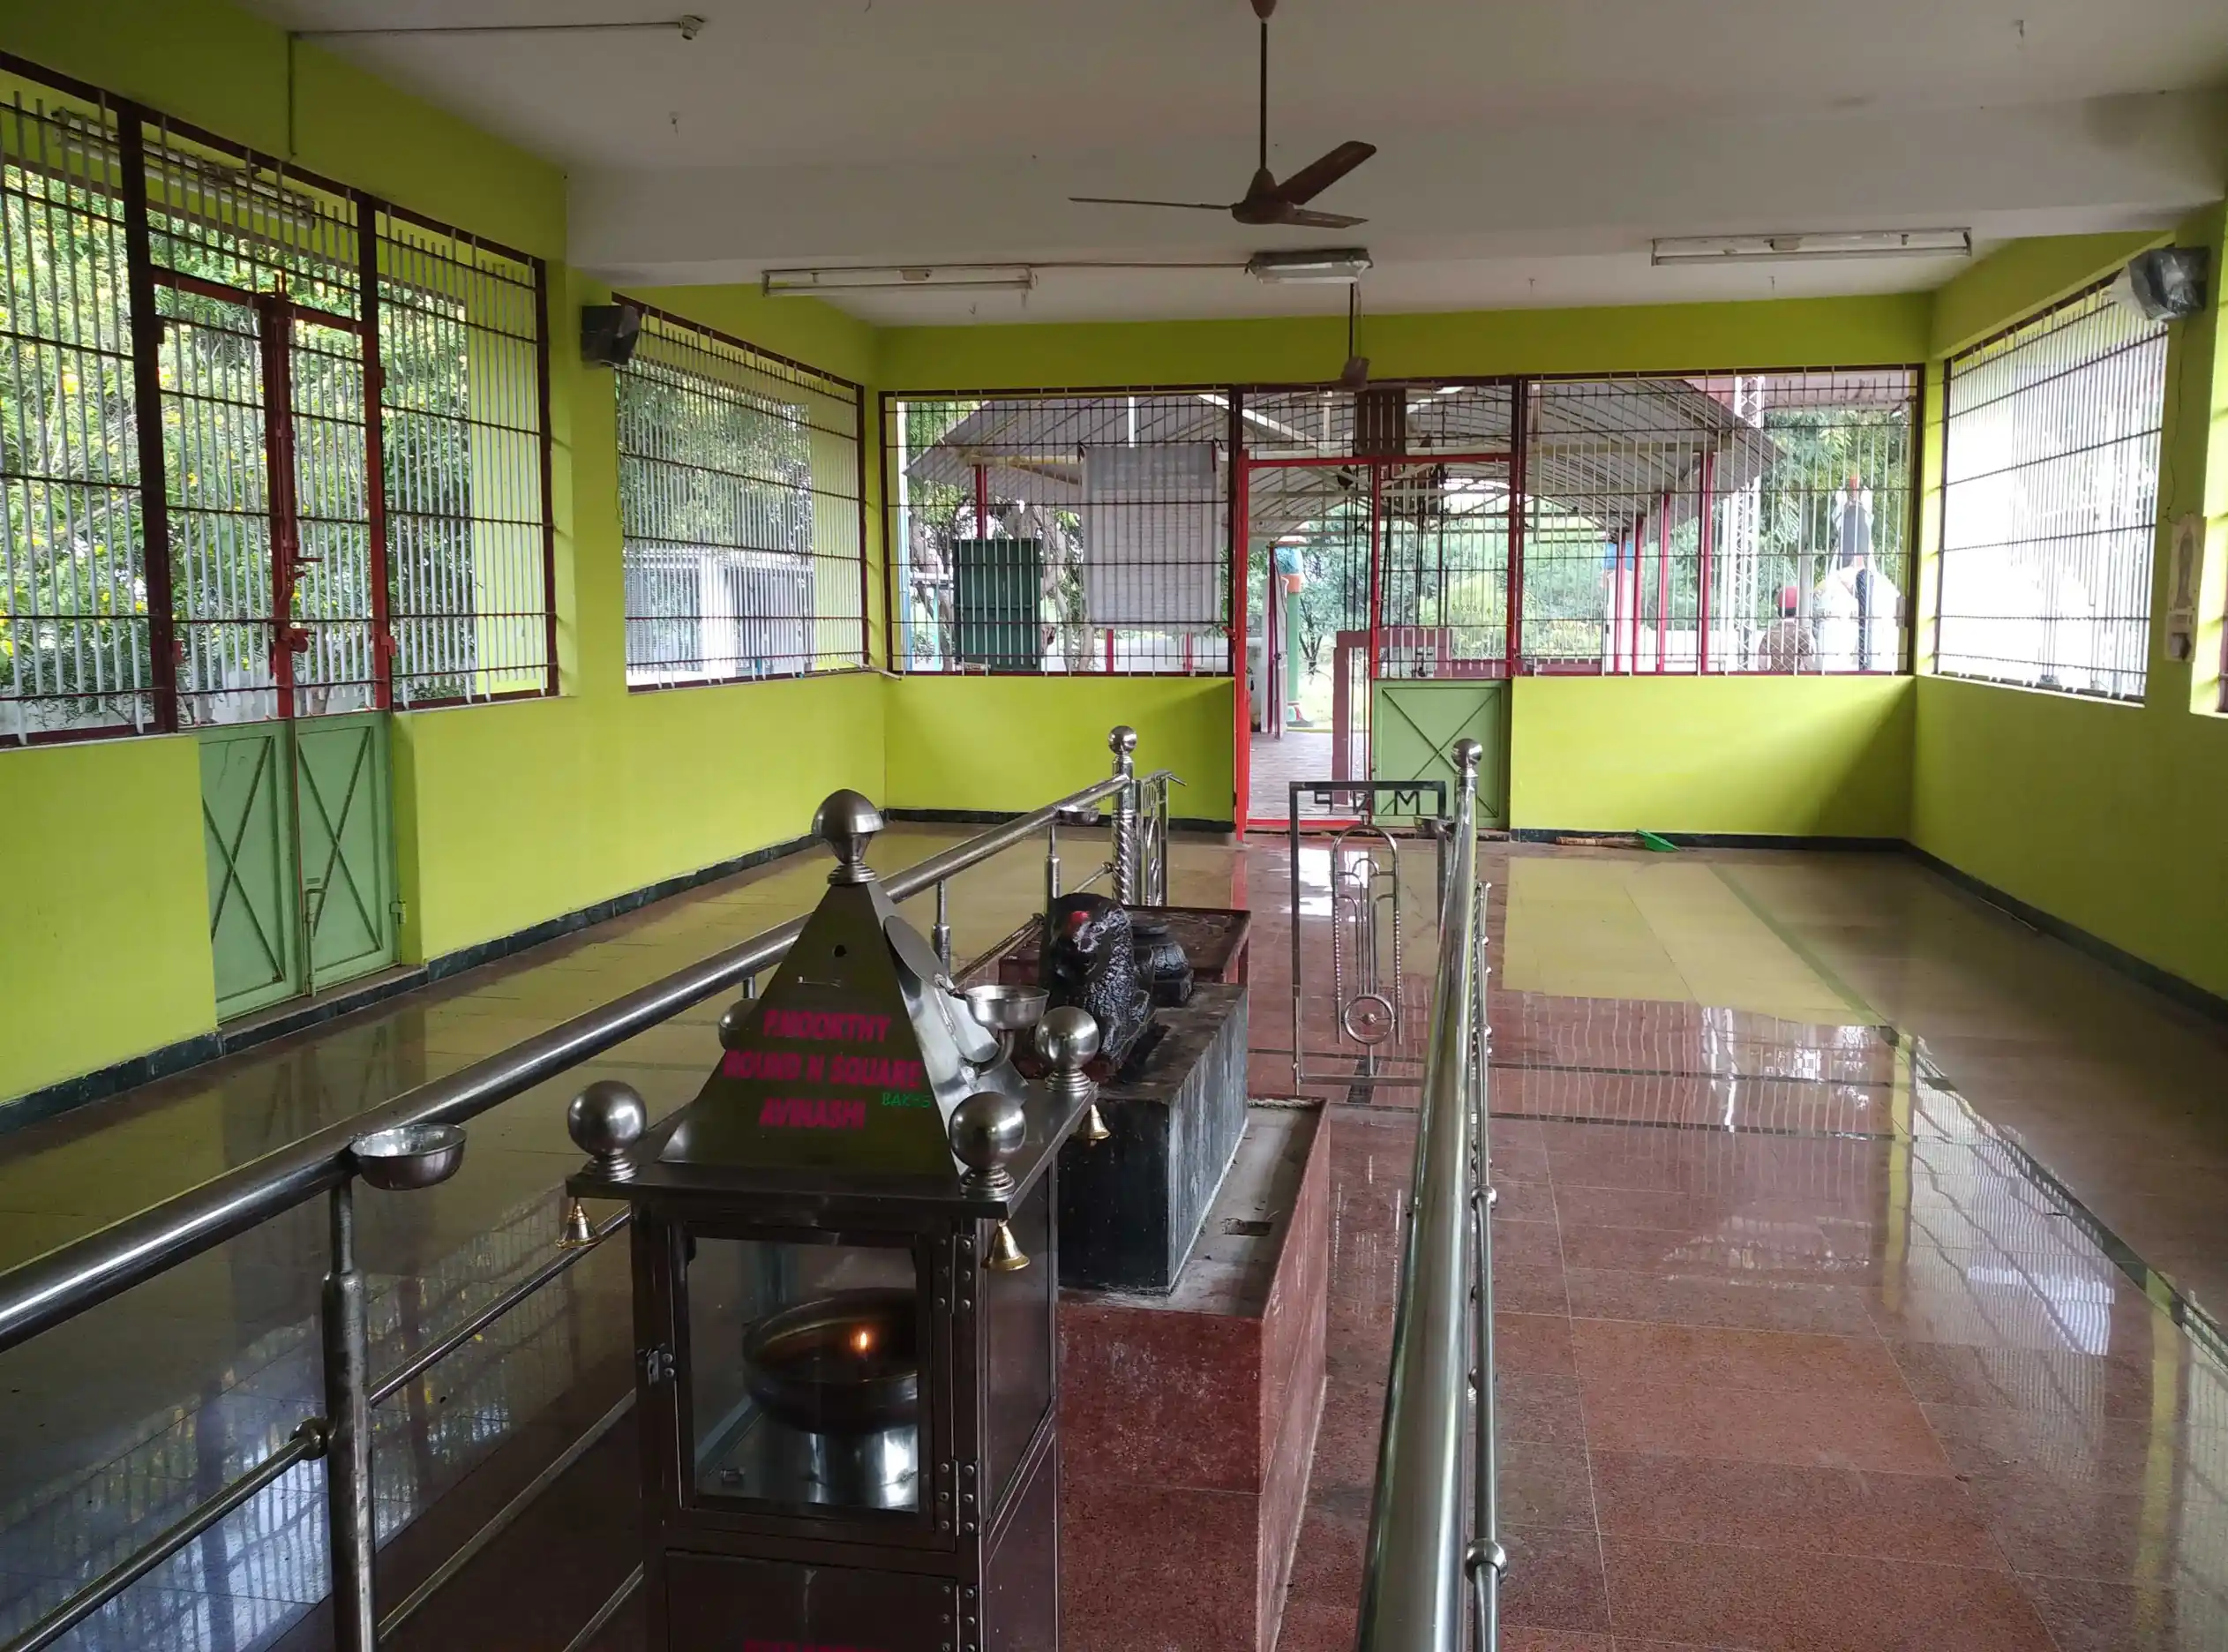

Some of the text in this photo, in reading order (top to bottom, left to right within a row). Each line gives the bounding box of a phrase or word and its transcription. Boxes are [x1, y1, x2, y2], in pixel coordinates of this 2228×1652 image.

[724, 1049, 923, 1089] ROUND N SQUARE
[760, 1097, 866, 1130] AVINASHI
